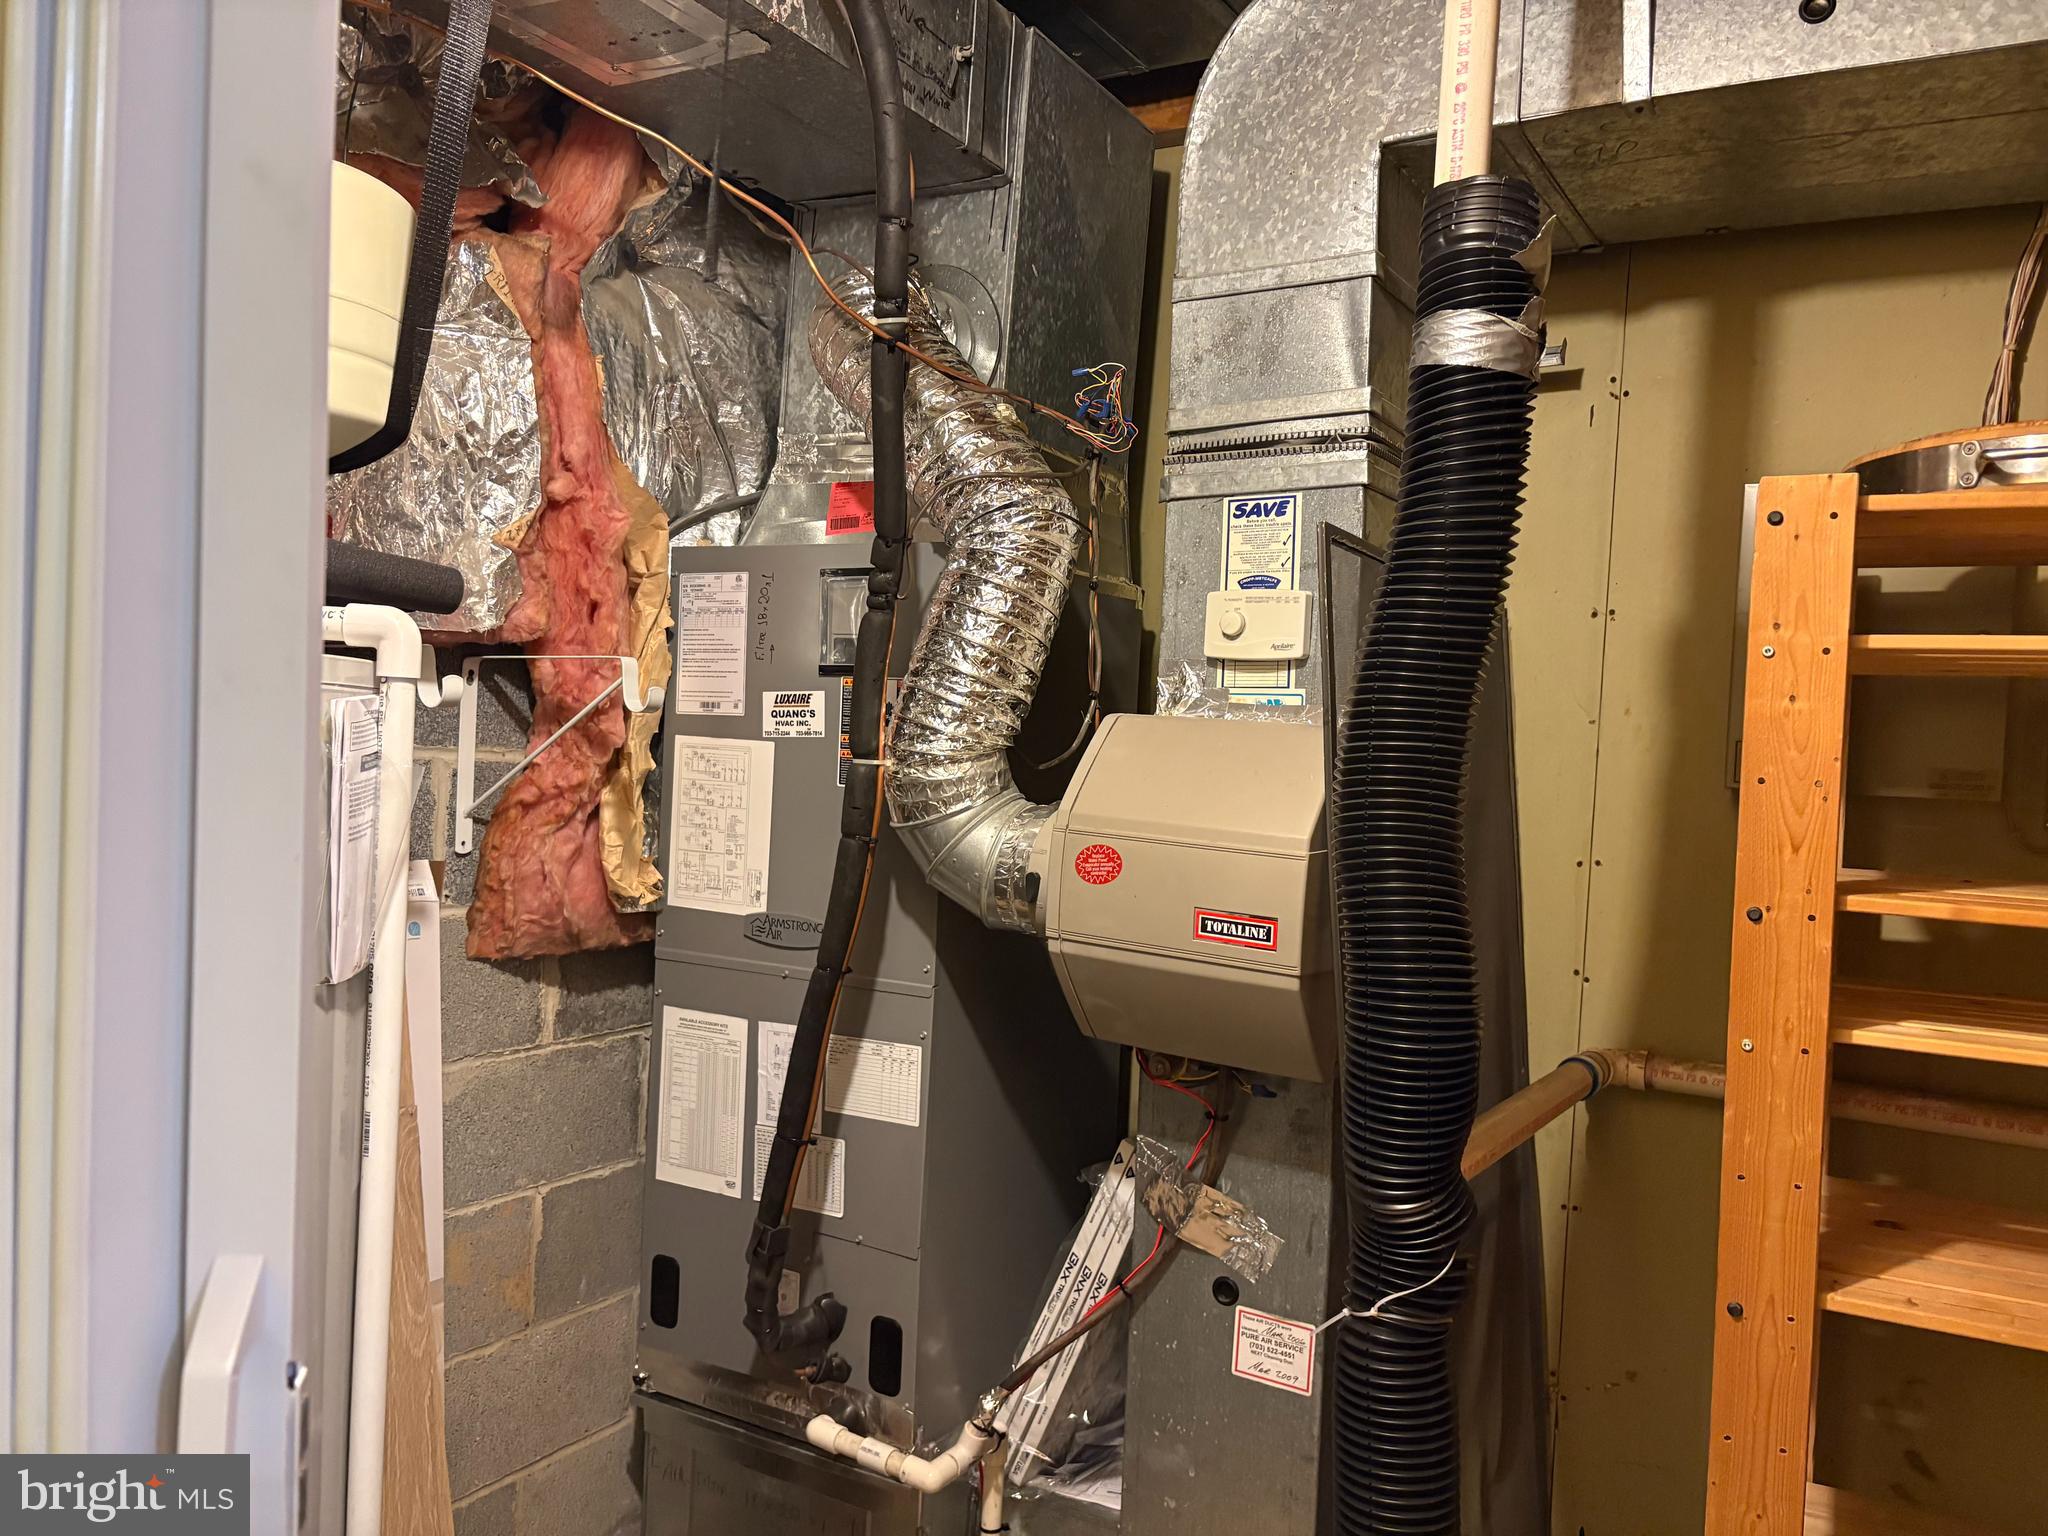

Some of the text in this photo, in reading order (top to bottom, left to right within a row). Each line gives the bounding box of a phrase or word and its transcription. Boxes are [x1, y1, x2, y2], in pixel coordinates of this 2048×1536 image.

[1233, 500, 1290, 519] SAVE
[774, 693, 813, 704] LUXAIRE
[771, 709, 816, 718] QUANG'S
[763, 914, 824, 933] ARMSTRONG
[1205, 920, 1267, 939] TOTALINE
[766, 927, 783, 940] AIR
[1060, 1252, 1079, 1284] BNX
[1074, 1265, 1092, 1298] BNX
[1090, 1272, 1108, 1305] BNX
[1242, 1314, 1255, 1322] These
[1265, 1320, 1280, 1329] DUCTS
[1241, 1331, 1304, 1353] PURE AIR SERVICE
[1249, 1342, 1265, 1351] (703)
[1275, 1370, 1299, 1384] 2009
